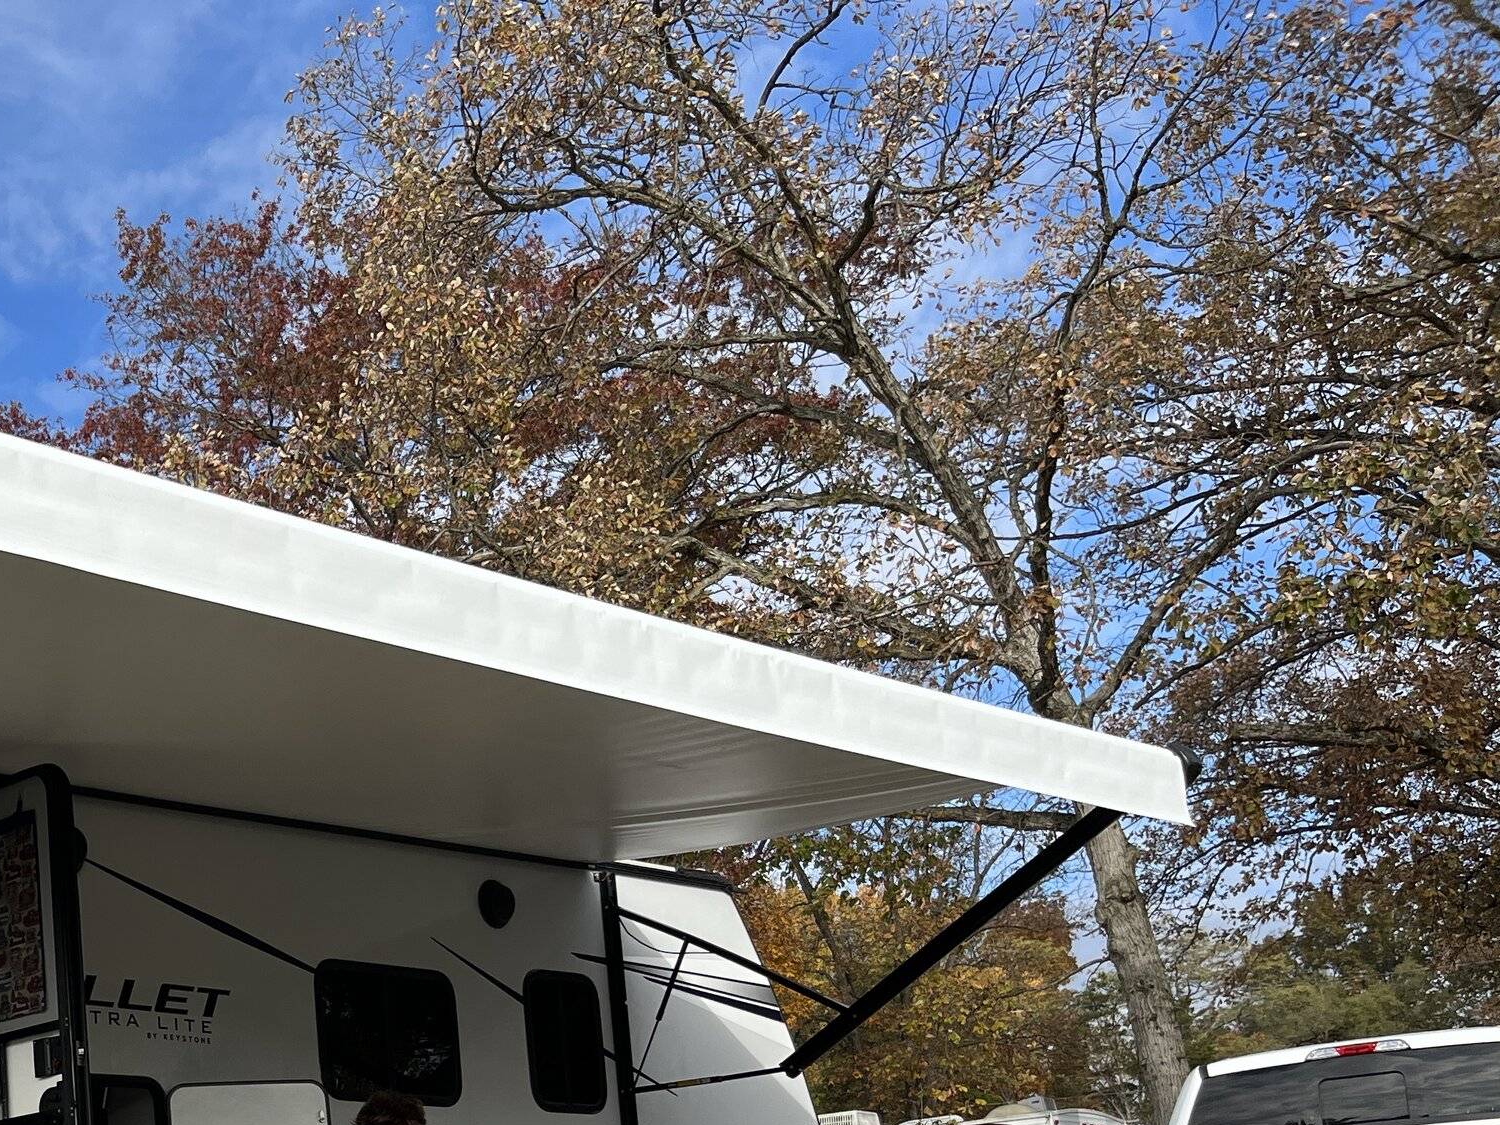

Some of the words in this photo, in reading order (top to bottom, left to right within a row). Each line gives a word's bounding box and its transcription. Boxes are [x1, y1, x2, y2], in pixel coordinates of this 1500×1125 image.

[157, 1016, 212, 1034] LITE
[147, 1032, 157, 1041] BY
[163, 1033, 212, 1044] KEYSTONE
